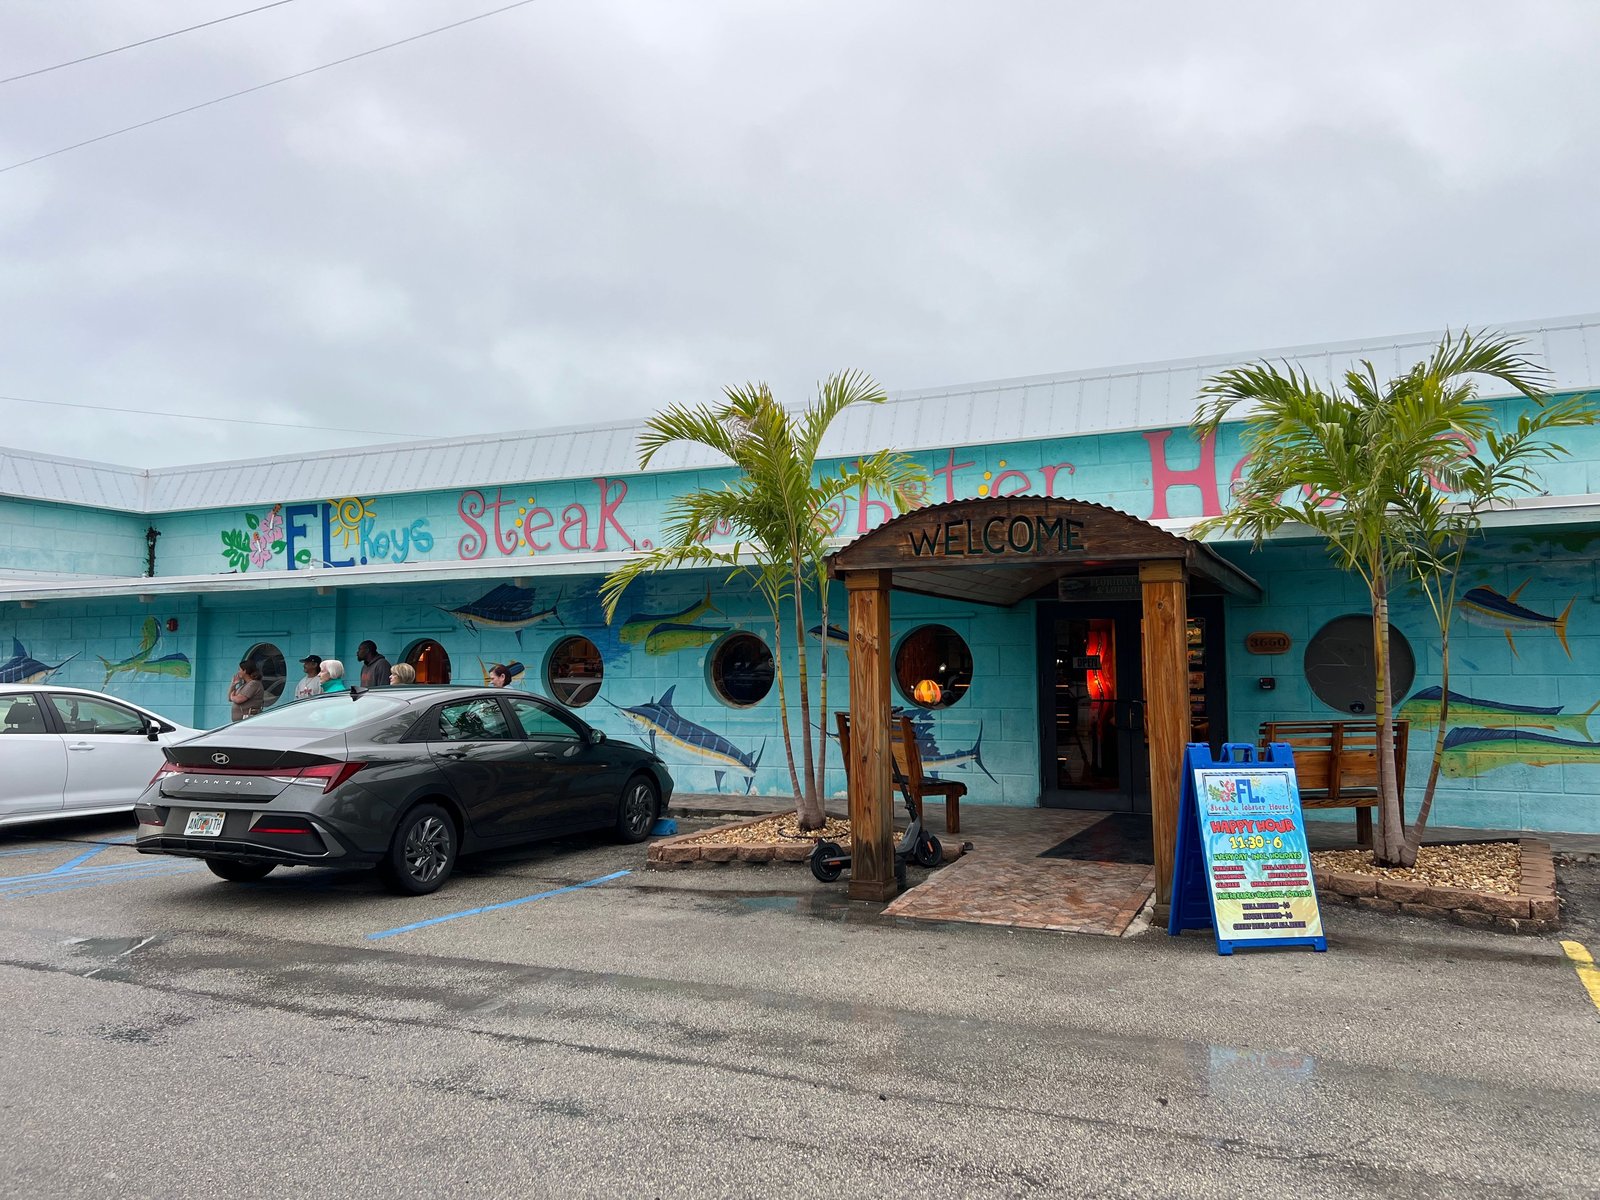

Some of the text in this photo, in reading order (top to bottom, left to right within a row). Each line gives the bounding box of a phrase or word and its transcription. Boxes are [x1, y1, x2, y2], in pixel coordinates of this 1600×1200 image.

[359, 517, 434, 563] Keys
[908, 515, 1085, 557] WELCOME
[1077, 658, 1098, 667] OPEN
[184, 778, 253, 786] ELANTRA
[1210, 818, 1296, 834] HAPPY HOUR
[1229, 835, 1264, 849] 11:30
[1273, 835, 1283, 849] 6
